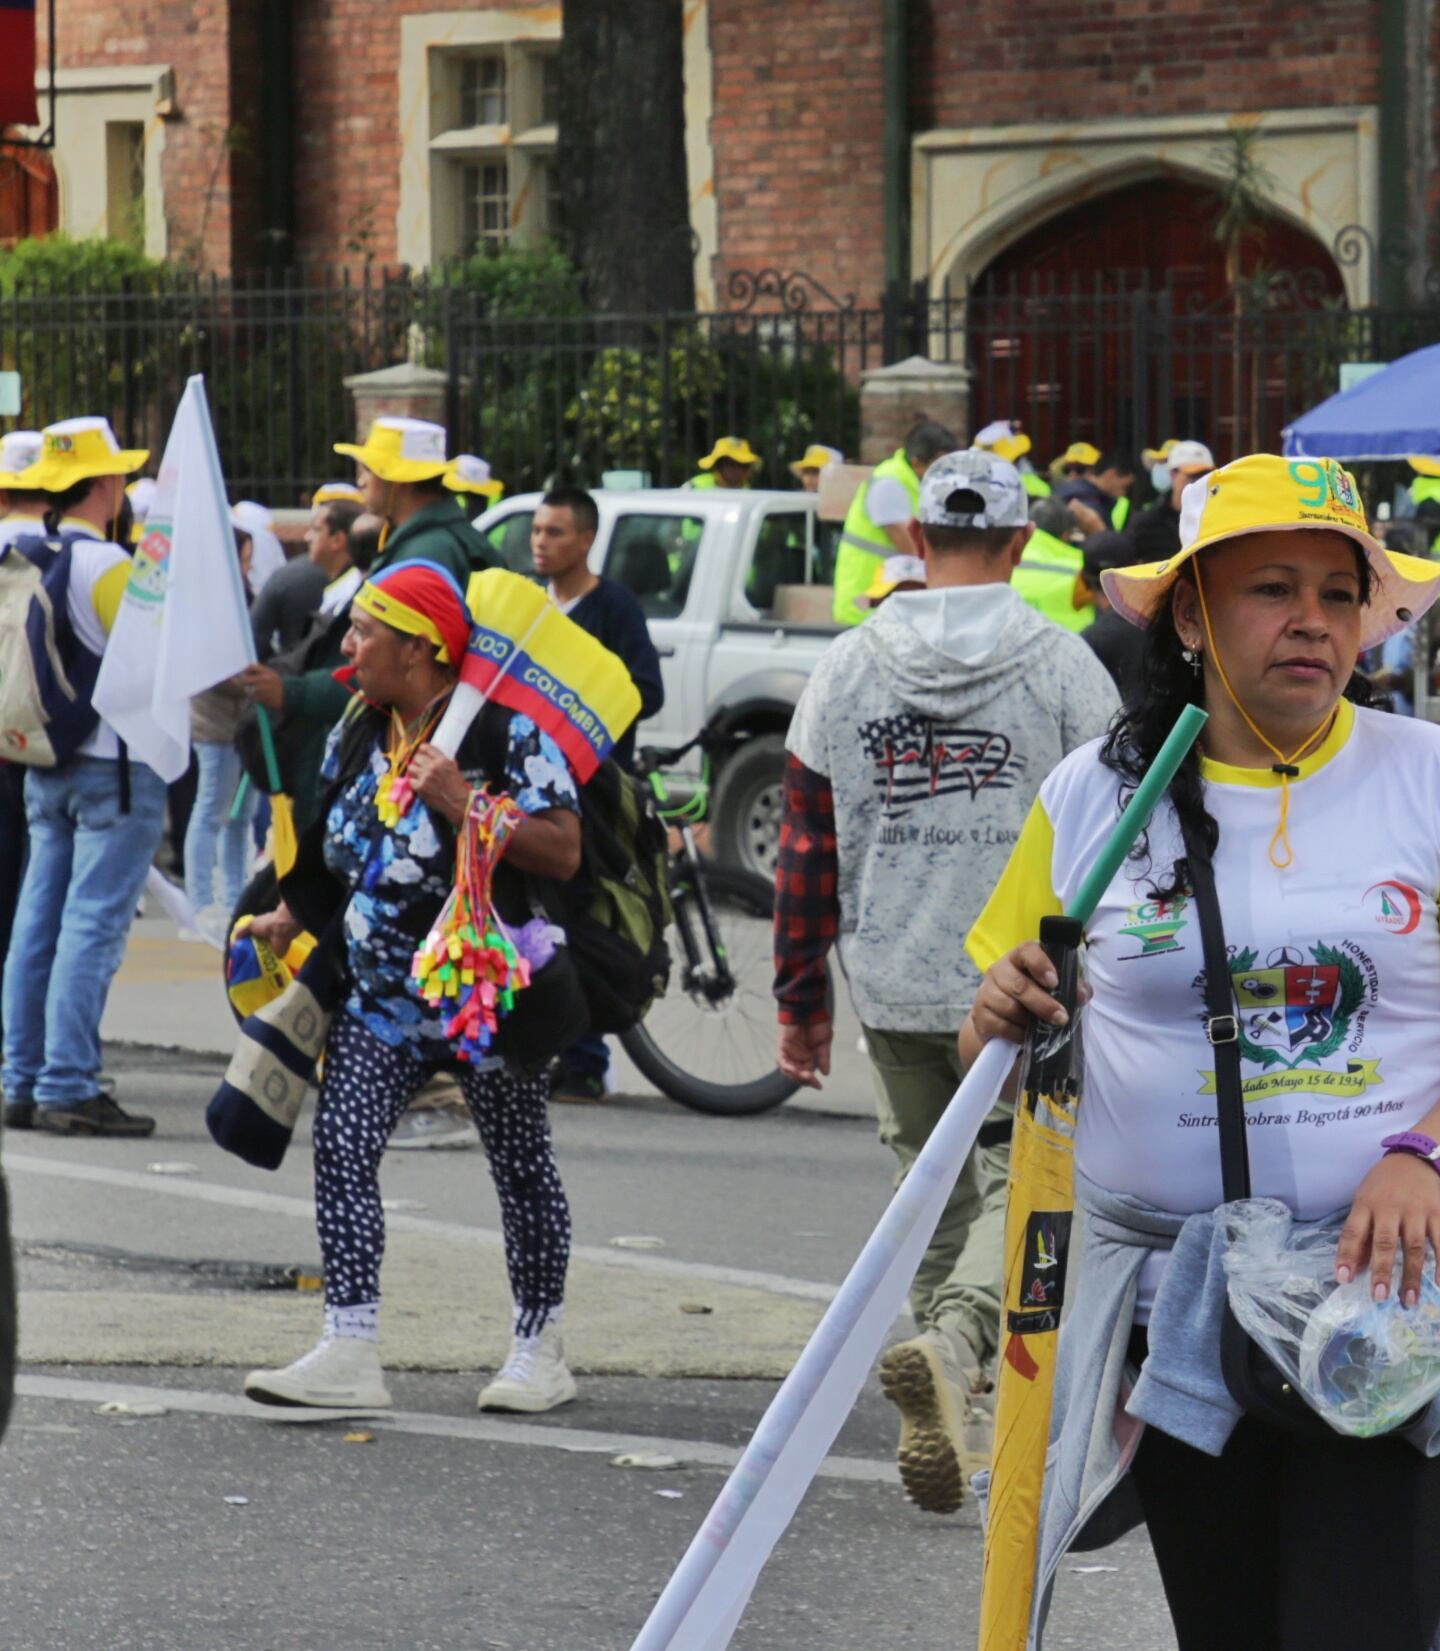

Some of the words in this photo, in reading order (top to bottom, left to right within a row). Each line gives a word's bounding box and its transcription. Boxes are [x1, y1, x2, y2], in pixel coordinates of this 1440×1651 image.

[522, 667, 606, 750] COLOMBIA
[923, 825, 966, 846] Hope
[1341, 939, 1379, 1002] HONESTIDAD
[1348, 1009, 1370, 1054] SERVICIO
[1271, 1077, 1304, 1090] Mayo
[1308, 1075, 1321, 1085] 15
[1323, 1075, 1336, 1085] de
[1339, 1075, 1364, 1088] 1934
[1296, 1106, 1350, 1127] Bogotá
[1353, 1104, 1371, 1119] 90
[1373, 1099, 1405, 1115] Años
